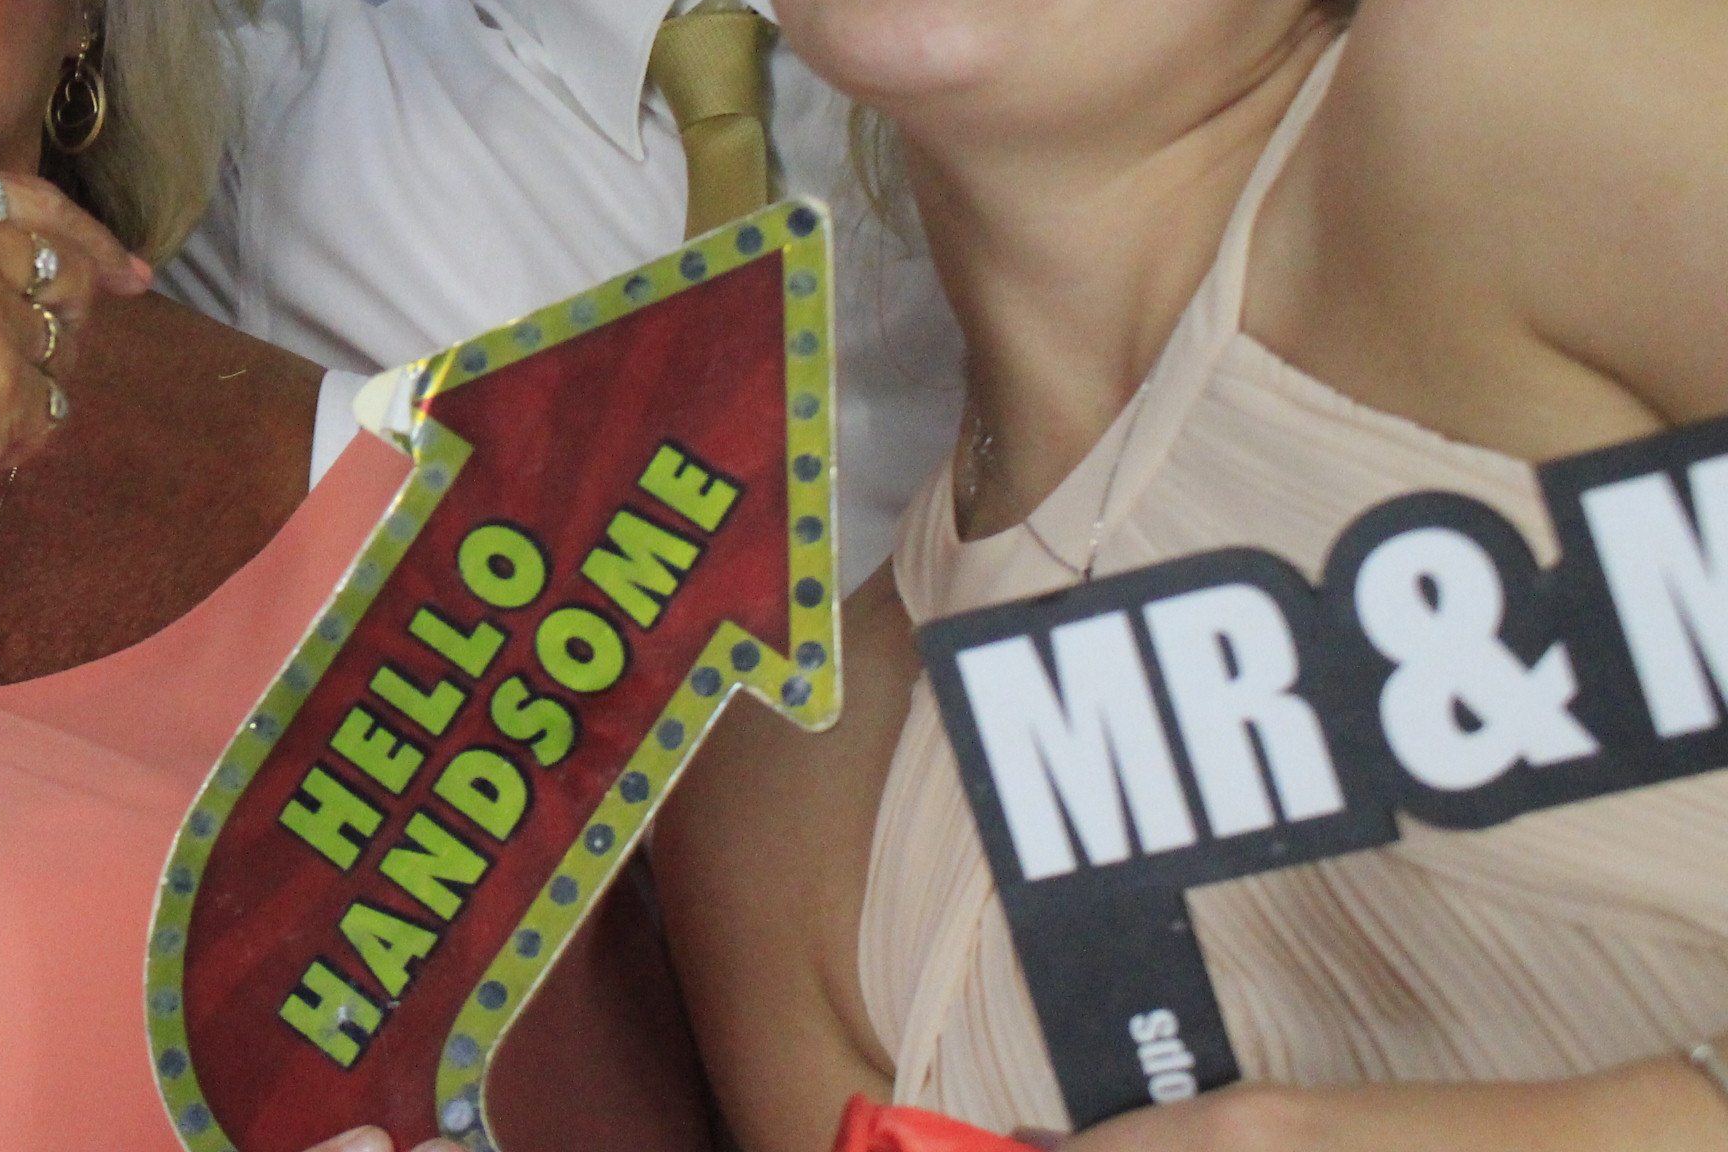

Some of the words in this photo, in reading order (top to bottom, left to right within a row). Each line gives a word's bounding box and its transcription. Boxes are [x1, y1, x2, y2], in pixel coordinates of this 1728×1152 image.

[276, 522, 549, 872] HELLO
[276, 442, 744, 1068] HANDSOME
[954, 581, 1346, 882] MR
[1353, 524, 1601, 793] &
